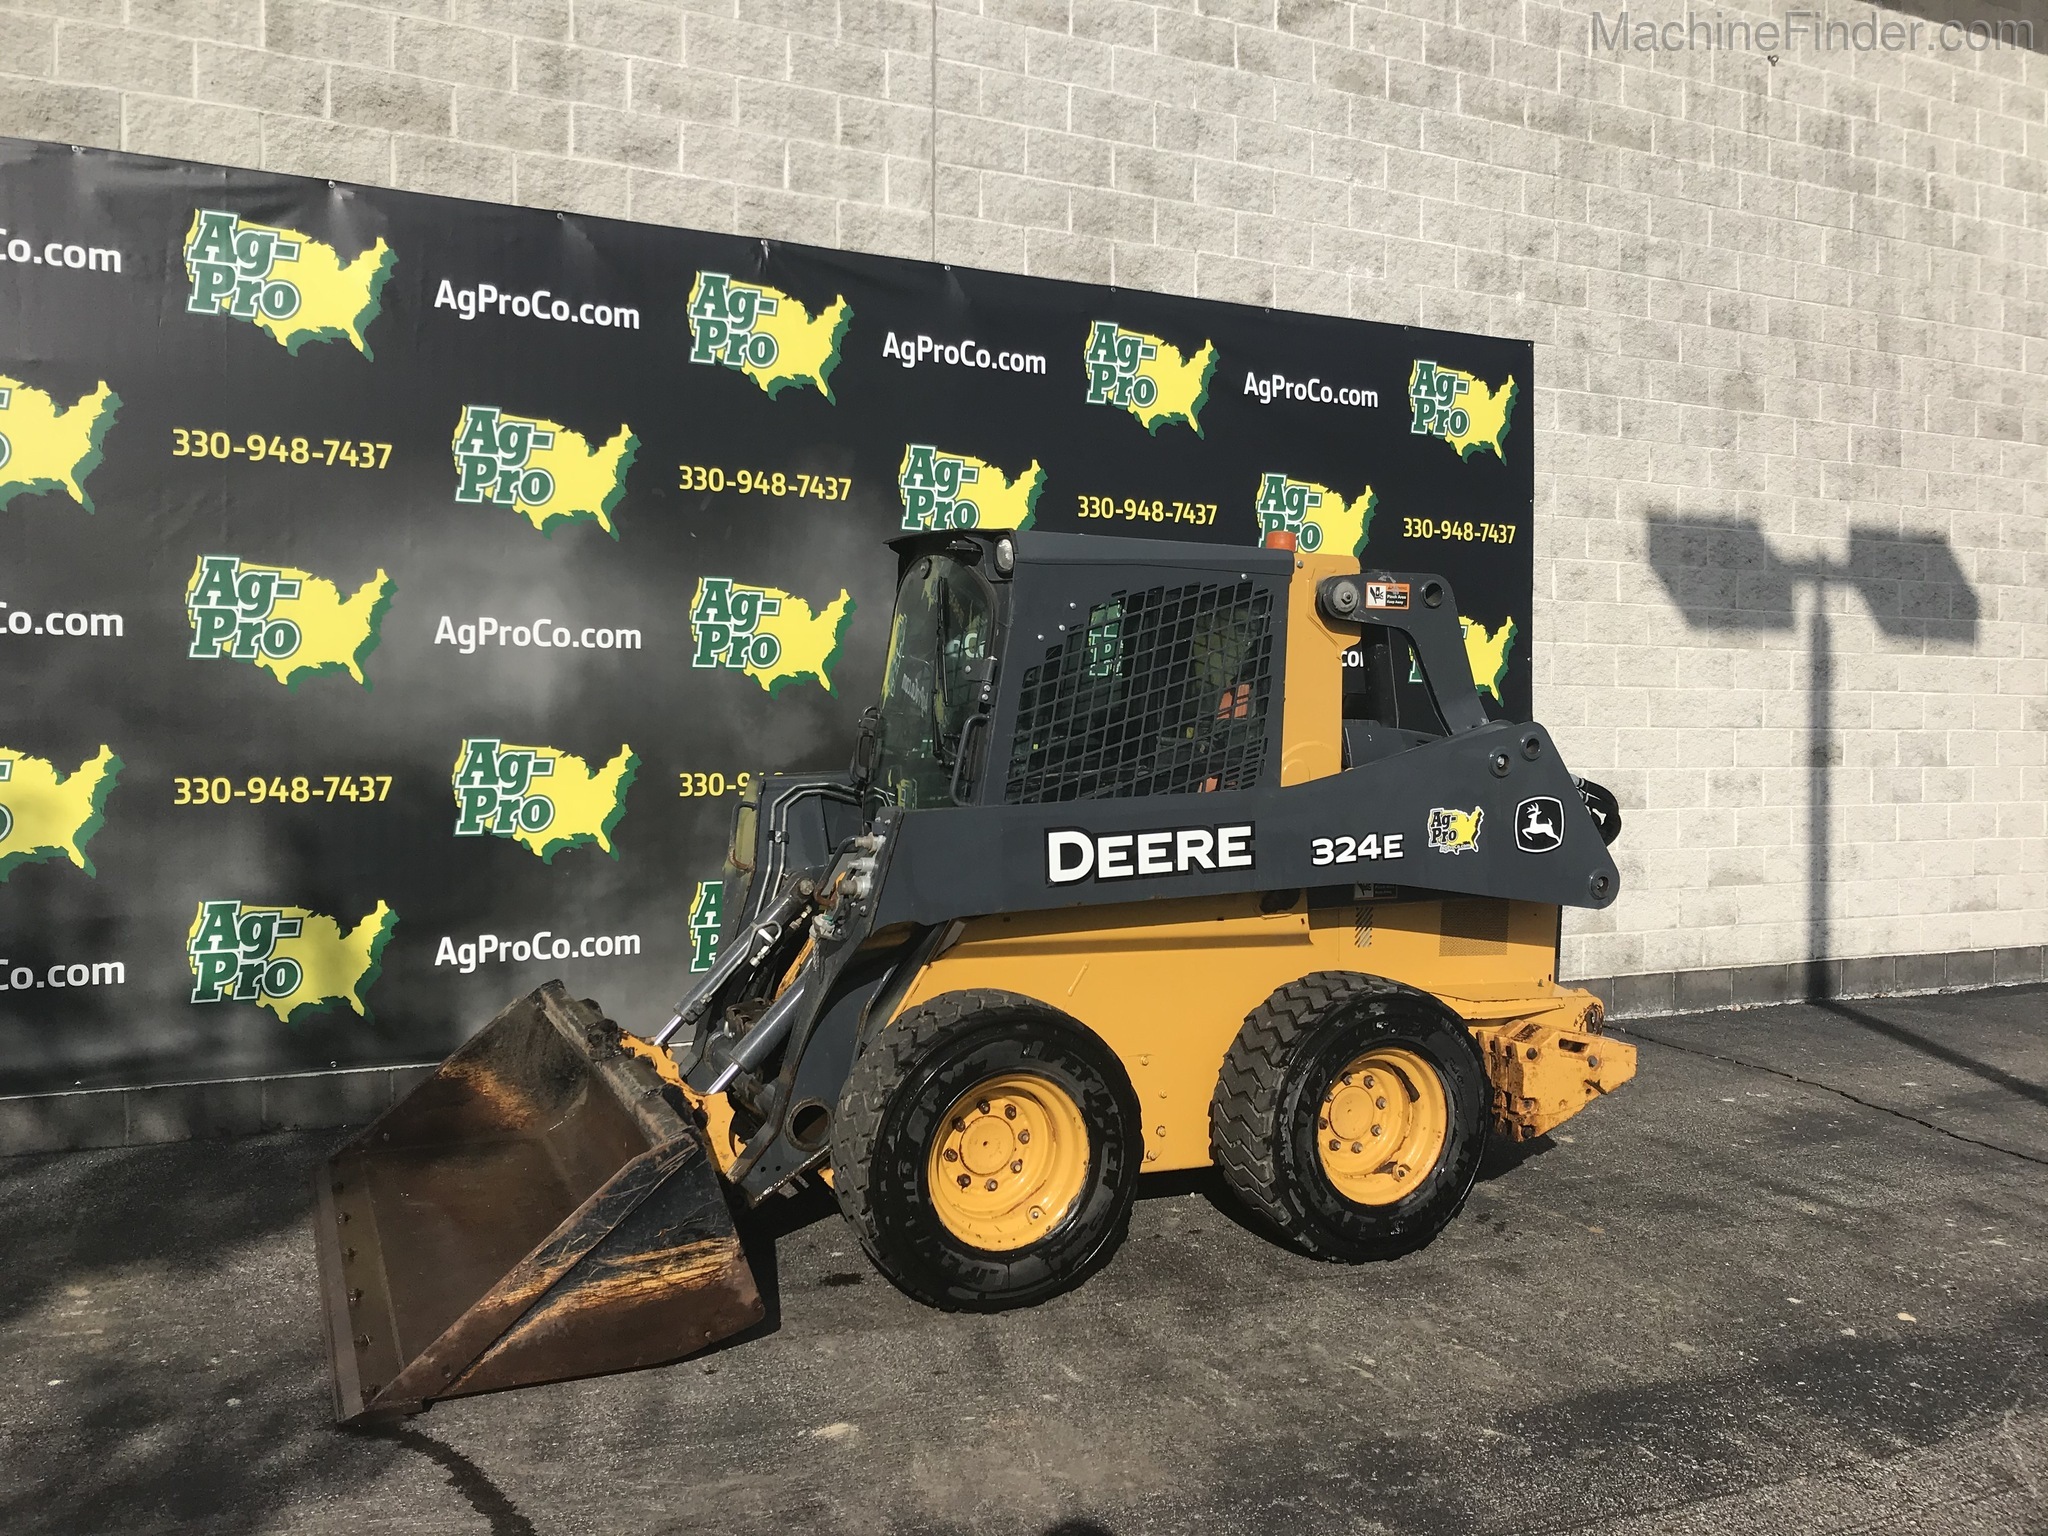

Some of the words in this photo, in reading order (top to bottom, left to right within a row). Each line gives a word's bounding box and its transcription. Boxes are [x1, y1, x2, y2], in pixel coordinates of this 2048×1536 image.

[187, 209, 300, 278] Ag-
[187, 261, 301, 320] Pro
[433, 279, 640, 330] AgProCo.com
[690, 271, 778, 331] Ag-
[689, 319, 779, 367] Pro
[882, 331, 1046, 375] AgProCo.com
[1086, 321, 1157, 374] Ag-
[1086, 363, 1157, 407] Pro
[1243, 371, 1379, 408] AgProCo.com
[1411, 360, 1469, 408] Ag-
[455, 406, 555, 467] Ag-
[1410, 397, 1470, 437] Pro
[172, 428, 393, 469] 330-948-7437
[901, 444, 979, 499] Ag-
[455, 454, 555, 505] Pro
[679, 465, 852, 501] 330-948-7437
[1258, 473, 1322, 527] Ag-
[901, 487, 980, 530] Pro
[1078, 495, 1218, 525] 330-948-7437
[1403, 517, 1517, 544] 330-948-7437
[189, 556, 302, 620] Ag-
[693, 577, 781, 637] Ag-
[188, 607, 302, 659] Pro
[433, 615, 643, 655] AgProCo.com
[692, 623, 781, 668] Pro
[174, 775, 394, 805] 330-948-7437
[455, 739, 555, 796] Ag-
[454, 786, 555, 835] Pro
[1431, 810, 1458, 830] Ag-
[1047, 825, 1252, 884] DEERE
[1311, 833, 1404, 866] 324E
[1431, 828, 1458, 844] Pro
[190, 900, 303, 961] Ag-
[434, 931, 641, 974] AgProCo.com
[190, 951, 303, 1003] Pro
